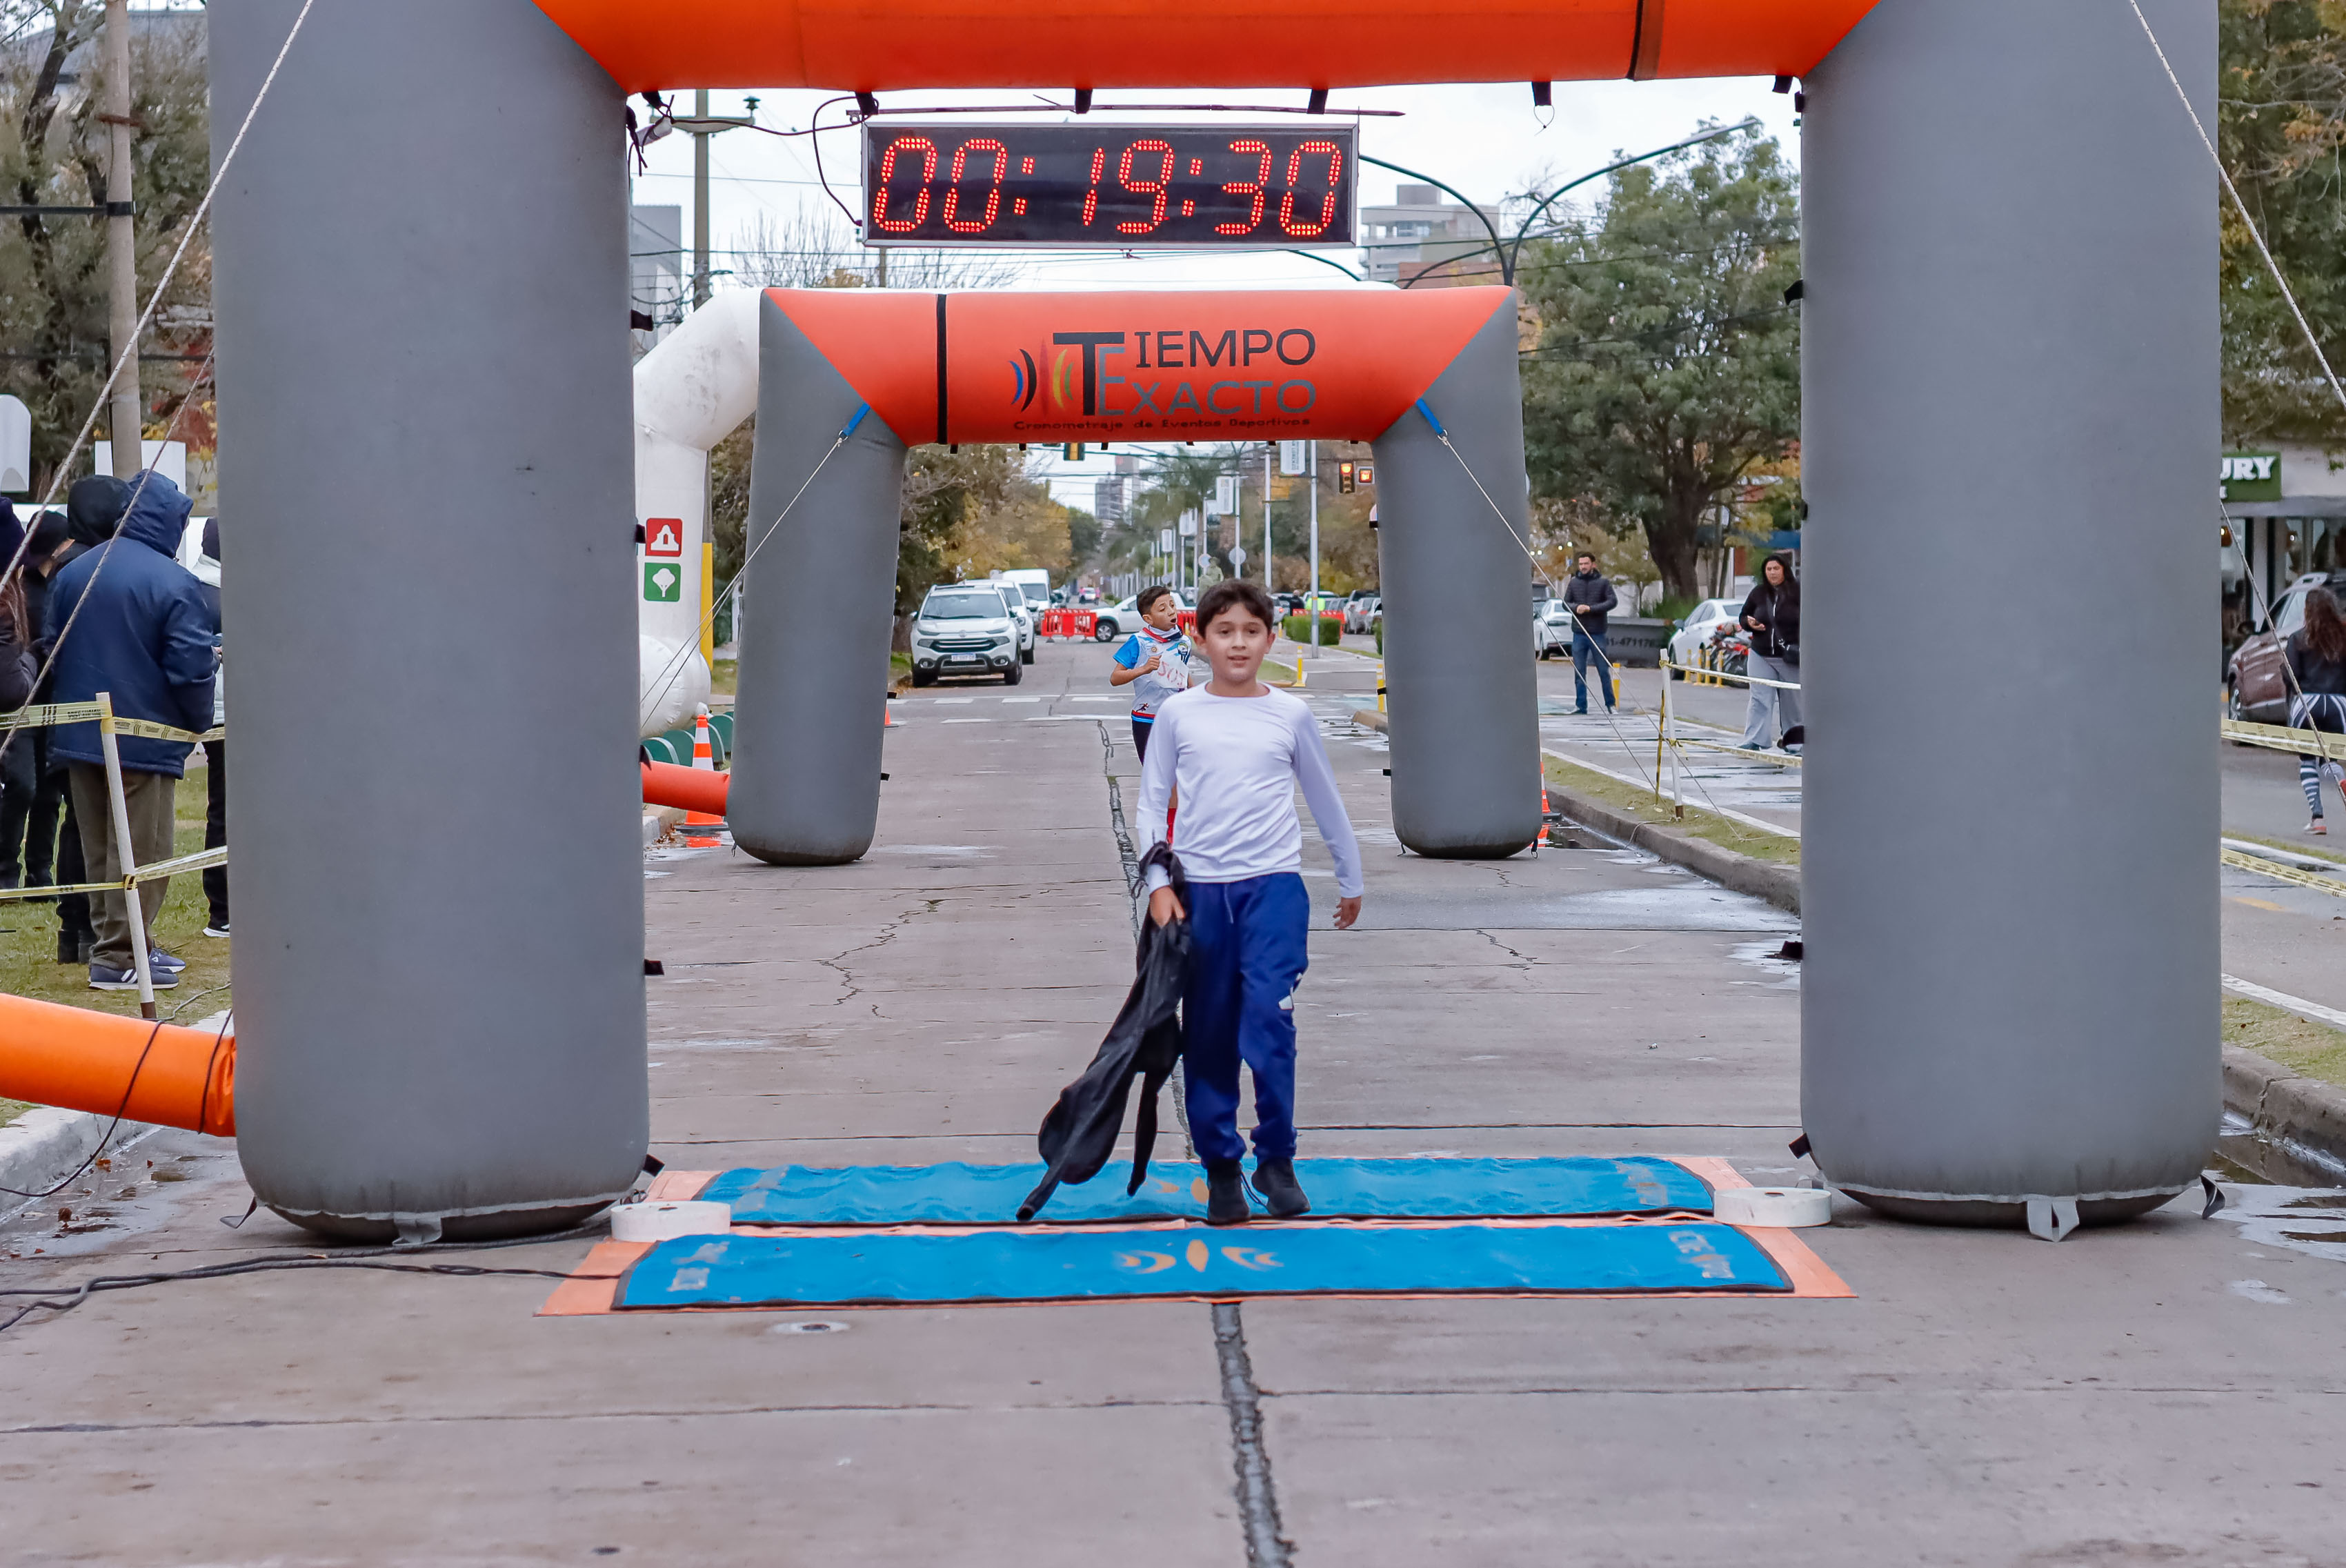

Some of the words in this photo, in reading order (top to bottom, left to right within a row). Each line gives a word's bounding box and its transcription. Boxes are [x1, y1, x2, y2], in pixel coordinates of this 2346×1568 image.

[873, 137, 1342, 237] 00:19:30
[1053, 328, 1316, 416] TIEMPO
[1097, 346, 1316, 417] EXACTO
[1013, 420, 1124, 433] Cronometraje
[1133, 419, 1153, 428] de
[1162, 419, 1222, 428] Eventos
[1229, 417, 1311, 428] Deportivos
